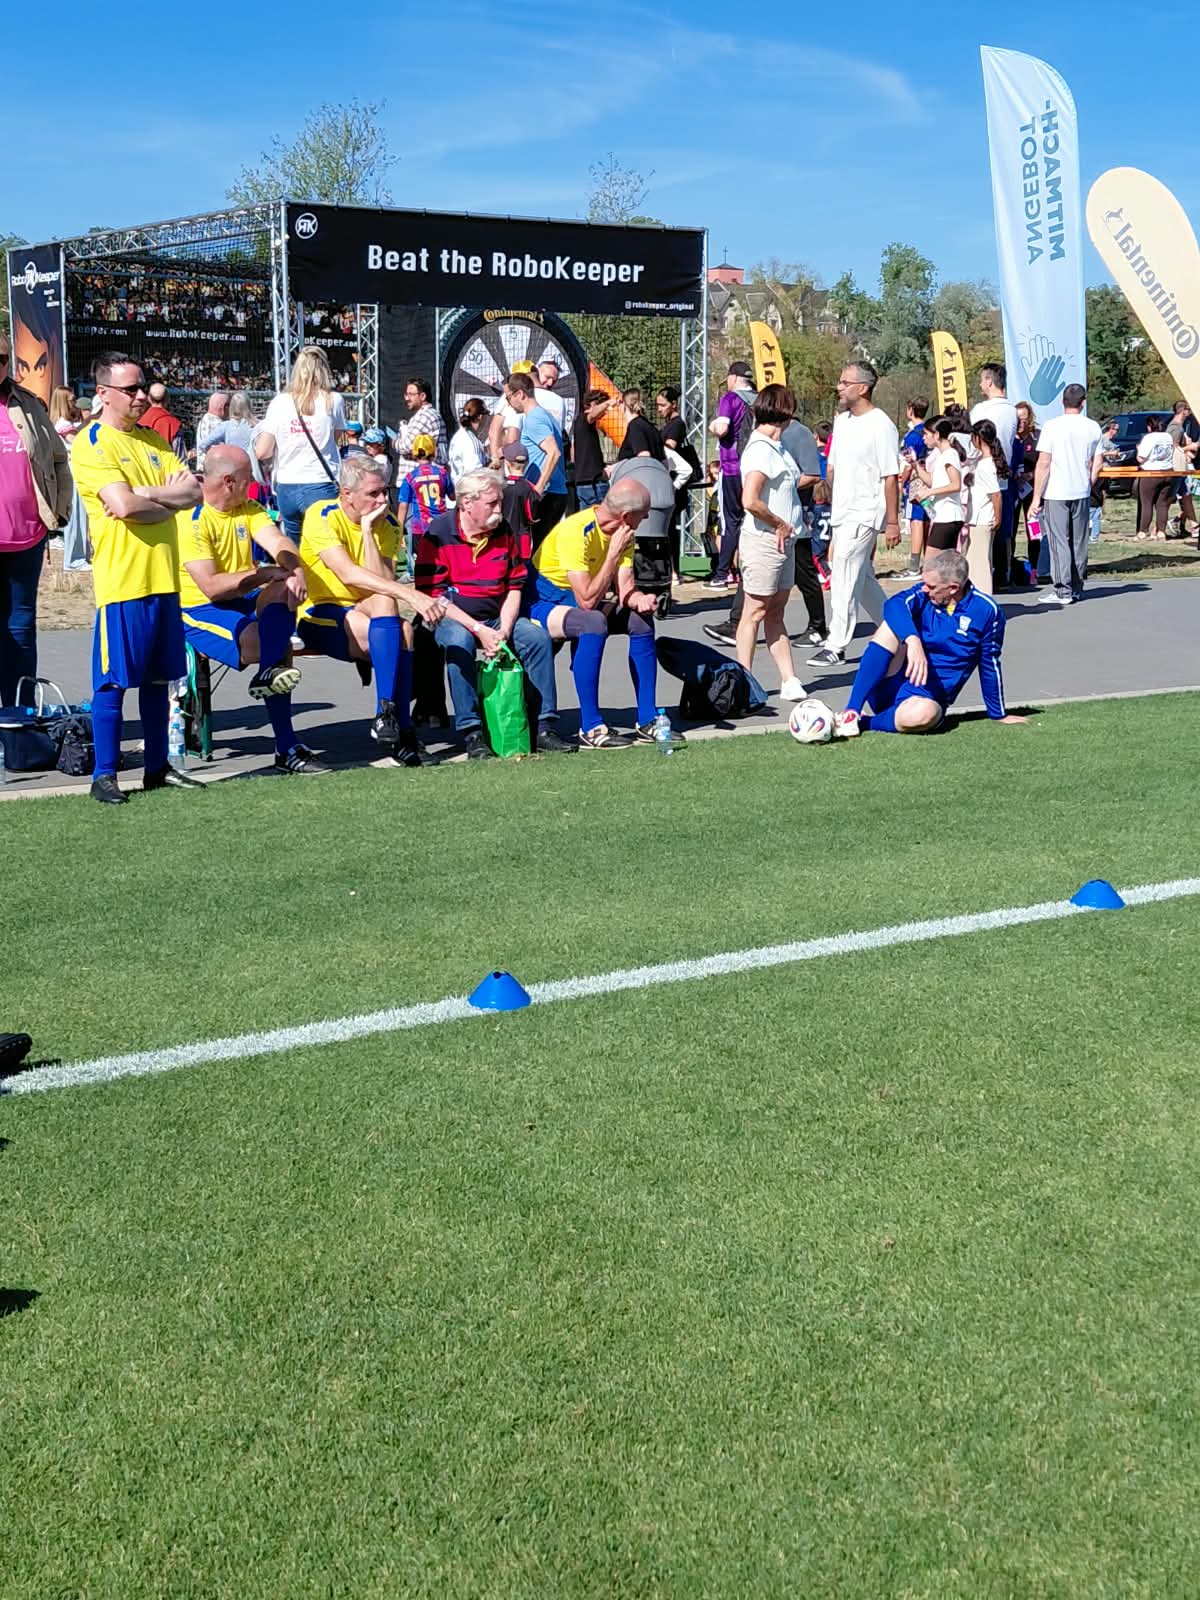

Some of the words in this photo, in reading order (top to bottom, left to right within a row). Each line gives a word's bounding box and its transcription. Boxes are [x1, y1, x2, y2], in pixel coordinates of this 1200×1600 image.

[368, 245, 429, 272] Beat
[440, 249, 482, 275] the
[492, 252, 645, 286] RoboKeeper
[418, 483, 440, 507] 19
